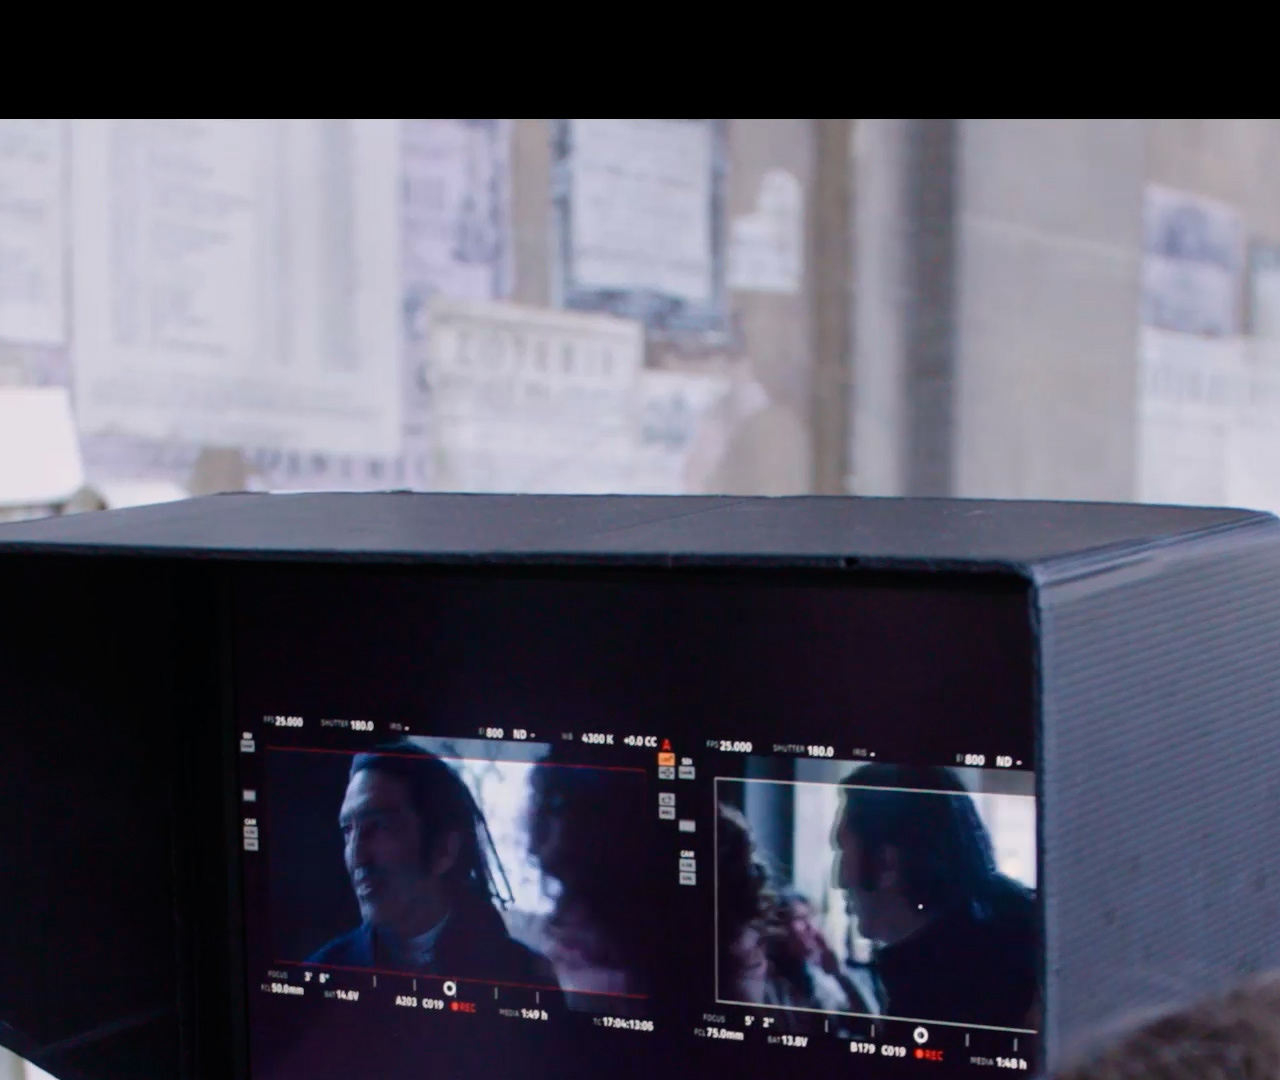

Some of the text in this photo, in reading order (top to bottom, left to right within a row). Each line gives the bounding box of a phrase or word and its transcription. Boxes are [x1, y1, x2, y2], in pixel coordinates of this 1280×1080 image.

[275, 715, 304, 728] 25.000
[320, 718, 349, 728] SHUTTER
[350, 720, 375, 732] 180.0
[486, 726, 504, 739] 800
[513, 728, 527, 740] ND
[581, 732, 605, 744] 4300
[606, 734, 614, 745] K
[644, 736, 658, 747] CC
[719, 740, 753, 752] 25.000
[773, 743, 806, 753] SHUTTER
[807, 745, 834, 757] 180.0
[964, 753, 985, 766] 800
[996, 755, 1012, 767] ND
[271, 982, 304, 996] 50.0mm
[395, 995, 417, 1008] A203
[422, 997, 444, 1010] C019
[460, 1002, 477, 1013] REC
[703, 1013, 726, 1024] FOCUS
[706, 1026, 745, 1041] 75.0mm
[781, 1034, 808, 1048] 13.8V
[850, 1041, 876, 1054] B179
[881, 1044, 907, 1057] C019
[925, 1049, 944, 1062] REC
[970, 1056, 994, 1067] MEDIA
